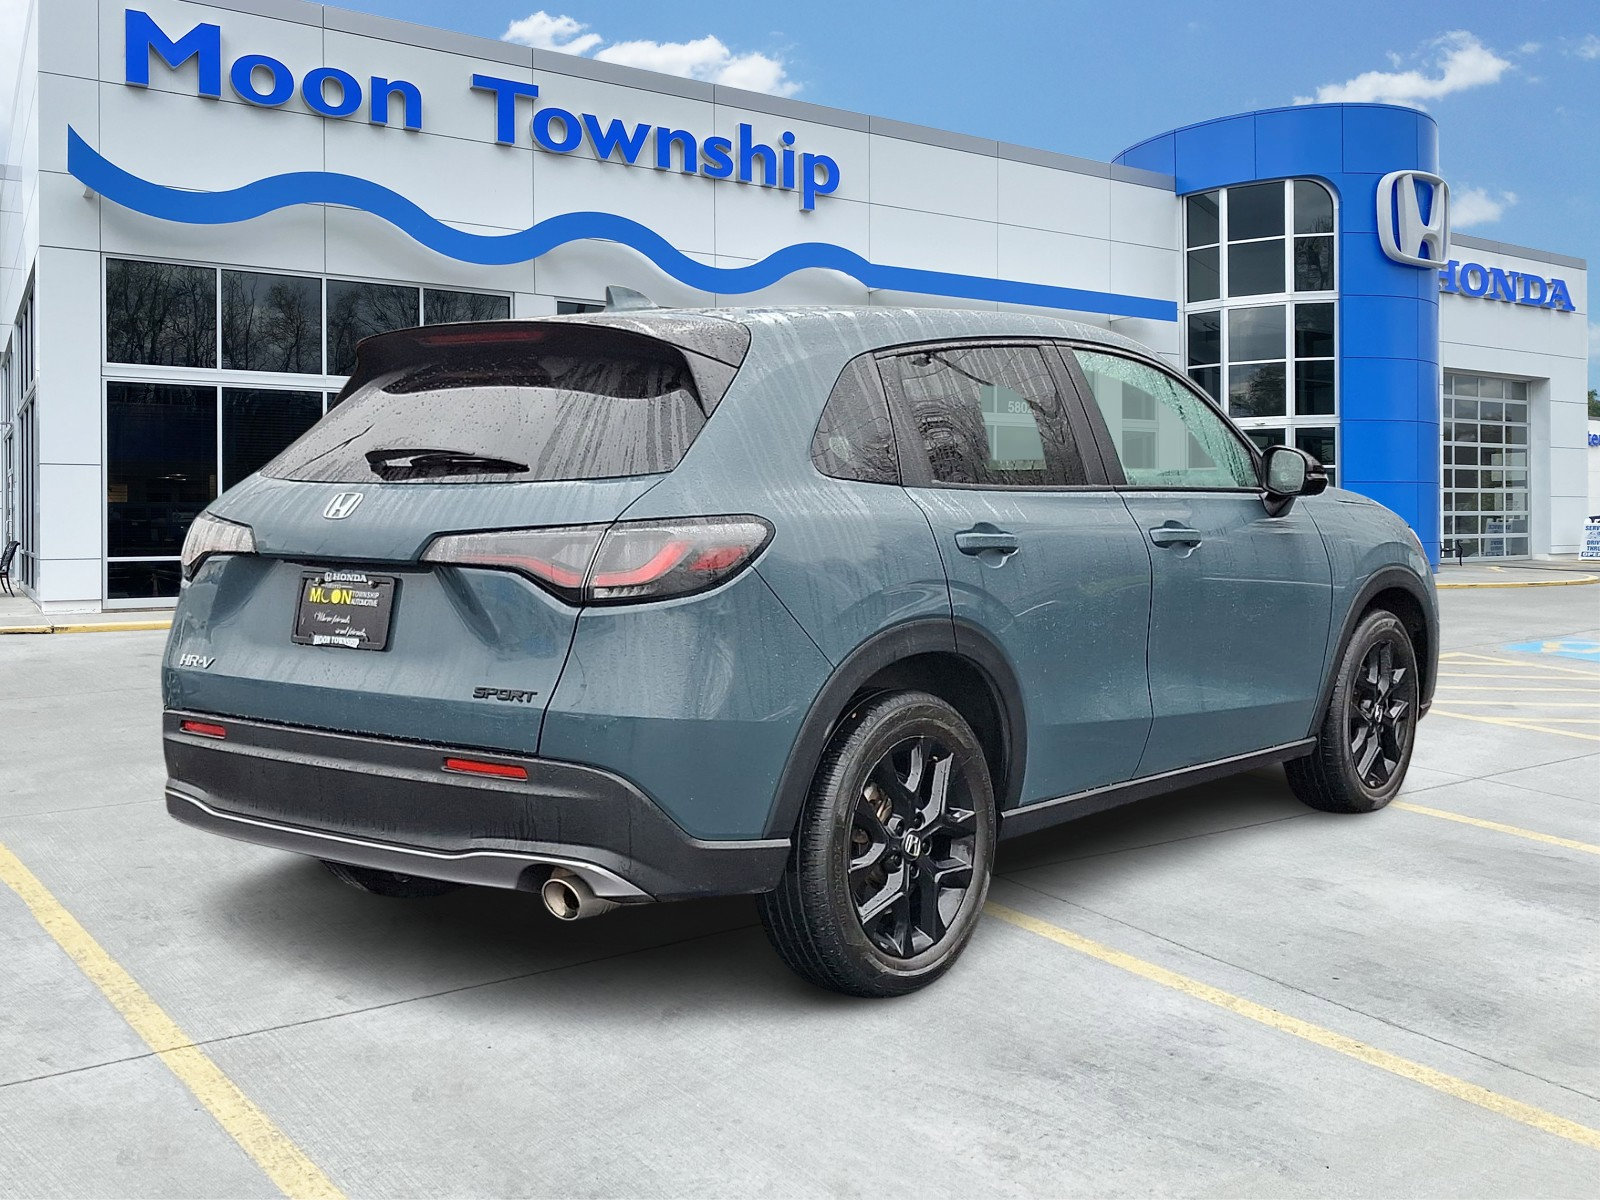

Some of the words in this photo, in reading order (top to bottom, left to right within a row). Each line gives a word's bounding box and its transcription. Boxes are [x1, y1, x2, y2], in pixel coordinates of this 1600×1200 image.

[125, 9, 422, 131] Moon
[470, 73, 841, 211] Township
[1438, 259, 1576, 312] HONDA
[333, 573, 367, 582] HONDA
[180, 653, 216, 669] HR-V
[473, 686, 538, 703] SPORT
